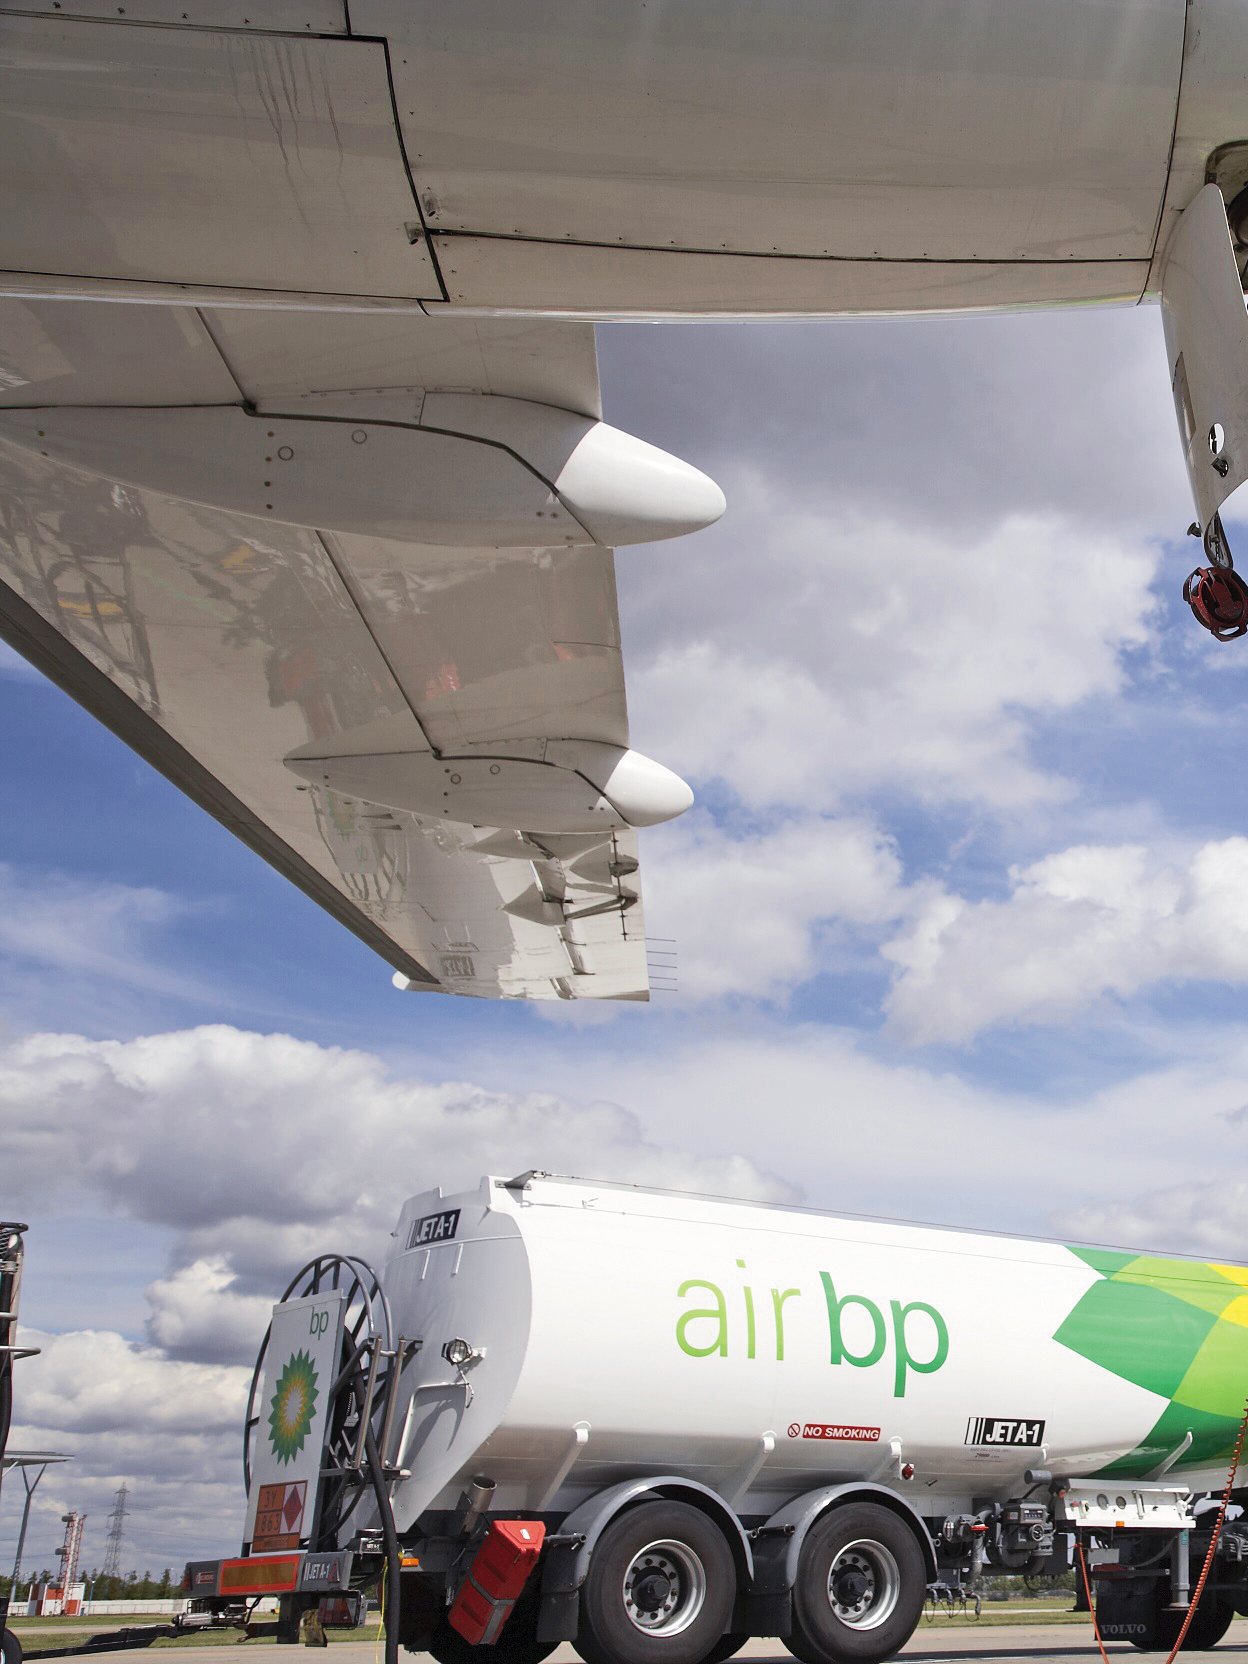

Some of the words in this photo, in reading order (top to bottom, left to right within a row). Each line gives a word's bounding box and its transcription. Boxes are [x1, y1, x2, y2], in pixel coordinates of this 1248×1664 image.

[416, 1217, 439, 1243] JET
[434, 1213, 456, 1239] A-1
[309, 1306, 329, 1341] bp
[675, 1258, 802, 1361] air
[818, 1270, 950, 1398] bp
[803, 1426, 823, 1437] NO
[825, 1426, 880, 1439] SMOKING
[985, 1421, 1018, 1443] JET
[1013, 1422, 1041, 1444] A-1
[309, 1563, 321, 1579] JET
[1101, 1623, 1147, 1635] VOLVO
